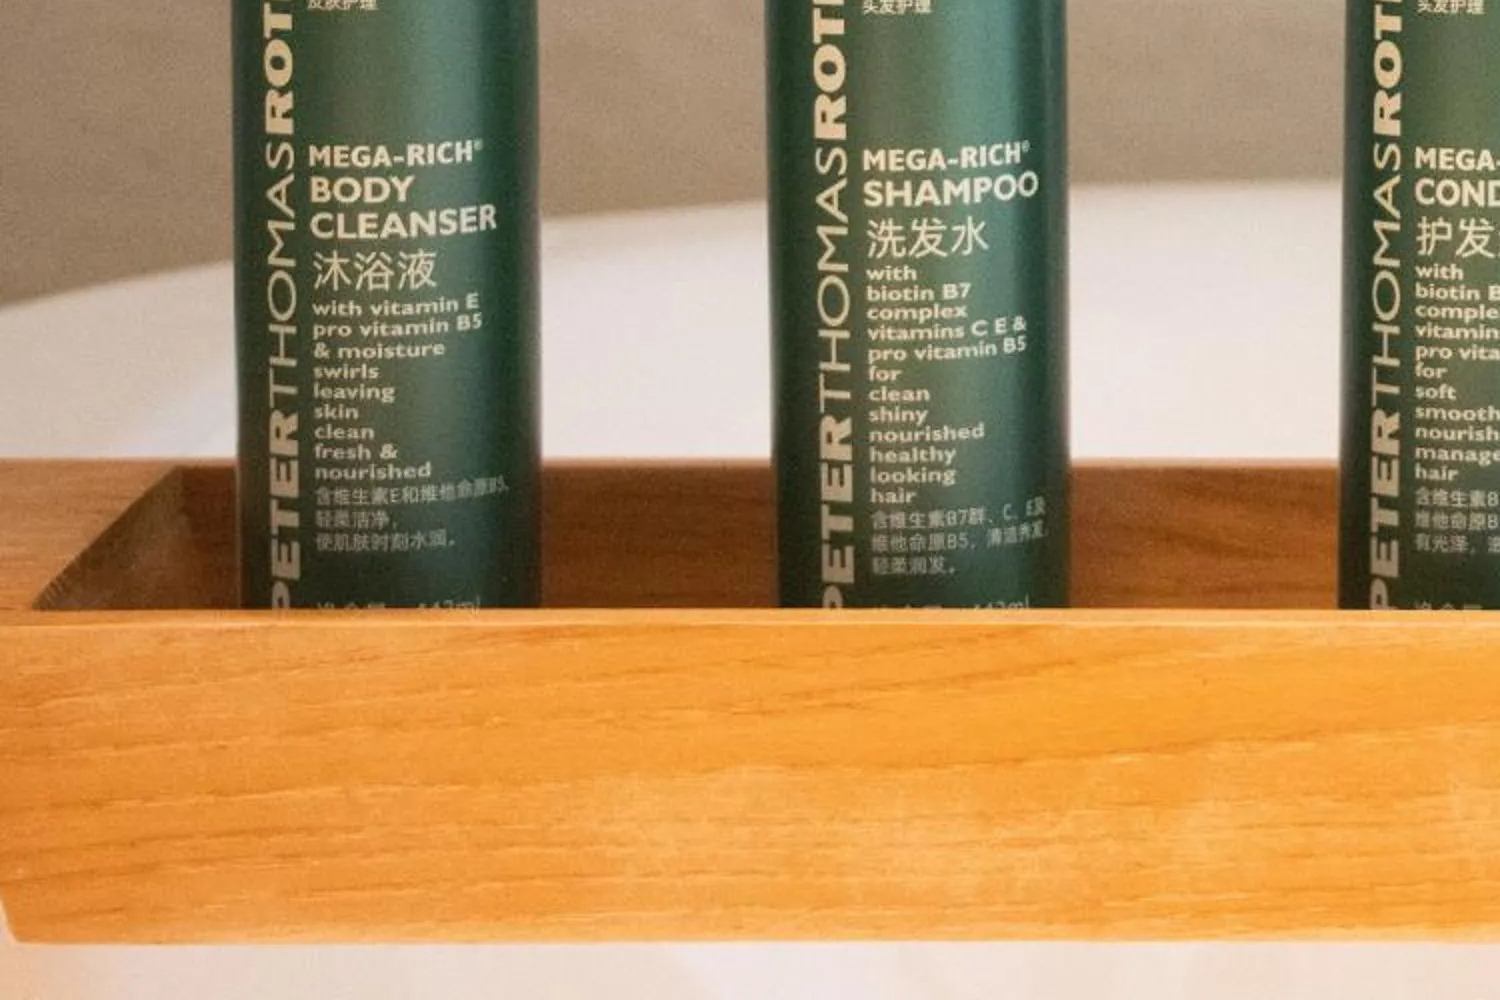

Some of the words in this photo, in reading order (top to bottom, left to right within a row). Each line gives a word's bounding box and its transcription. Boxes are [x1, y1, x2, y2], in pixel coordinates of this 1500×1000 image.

[310, 176, 415, 203] BODY
[863, 171, 1039, 207] SHAMPOO
[310, 204, 497, 240] CLEANSER
[867, 216, 989, 258] 洗发水
[313, 249, 438, 292] 沐浴液
[866, 265, 917, 281] with
[1415, 264, 1464, 280] with
[867, 286, 934, 302] biotin
[942, 283, 972, 299] B7
[1416, 283, 1481, 300] biotin
[312, 299, 362, 317] with
[370, 297, 459, 316] vitamin
[466, 292, 479, 310] E
[866, 304, 968, 324] complex
[312, 322, 352, 339] pro
[360, 319, 449, 337] vitamin
[457, 313, 482, 331] B5
[867, 324, 965, 341] vitamins
[971, 321, 988, 336] C
[995, 319, 1008, 334] E
[1013, 316, 1027, 332] &
[313, 342, 329, 359] &
[338, 342, 446, 359] moisture
[868, 348, 907, 365] pro
[914, 342, 998, 361] vitamin
[1003, 337, 1027, 353] B5
[1415, 346, 1452, 362] pro
[314, 364, 379, 379] swirls
[868, 366, 901, 382] for
[1415, 364, 1448, 379] for
[313, 384, 395, 403] leaving
[868, 387, 930, 402] clean
[1415, 384, 1457, 400] soft
[314, 404, 358, 419] skin
[869, 406, 928, 425] shiny
[314, 424, 374, 440] clean
[869, 423, 985, 442] nourished
[314, 444, 371, 459] fresh
[380, 444, 398, 459] &
[869, 446, 956, 465] healthy
[314, 462, 431, 480] nourished
[870, 467, 957, 486] looking
[1415, 464, 1459, 481] hair
[871, 488, 916, 504] hair
